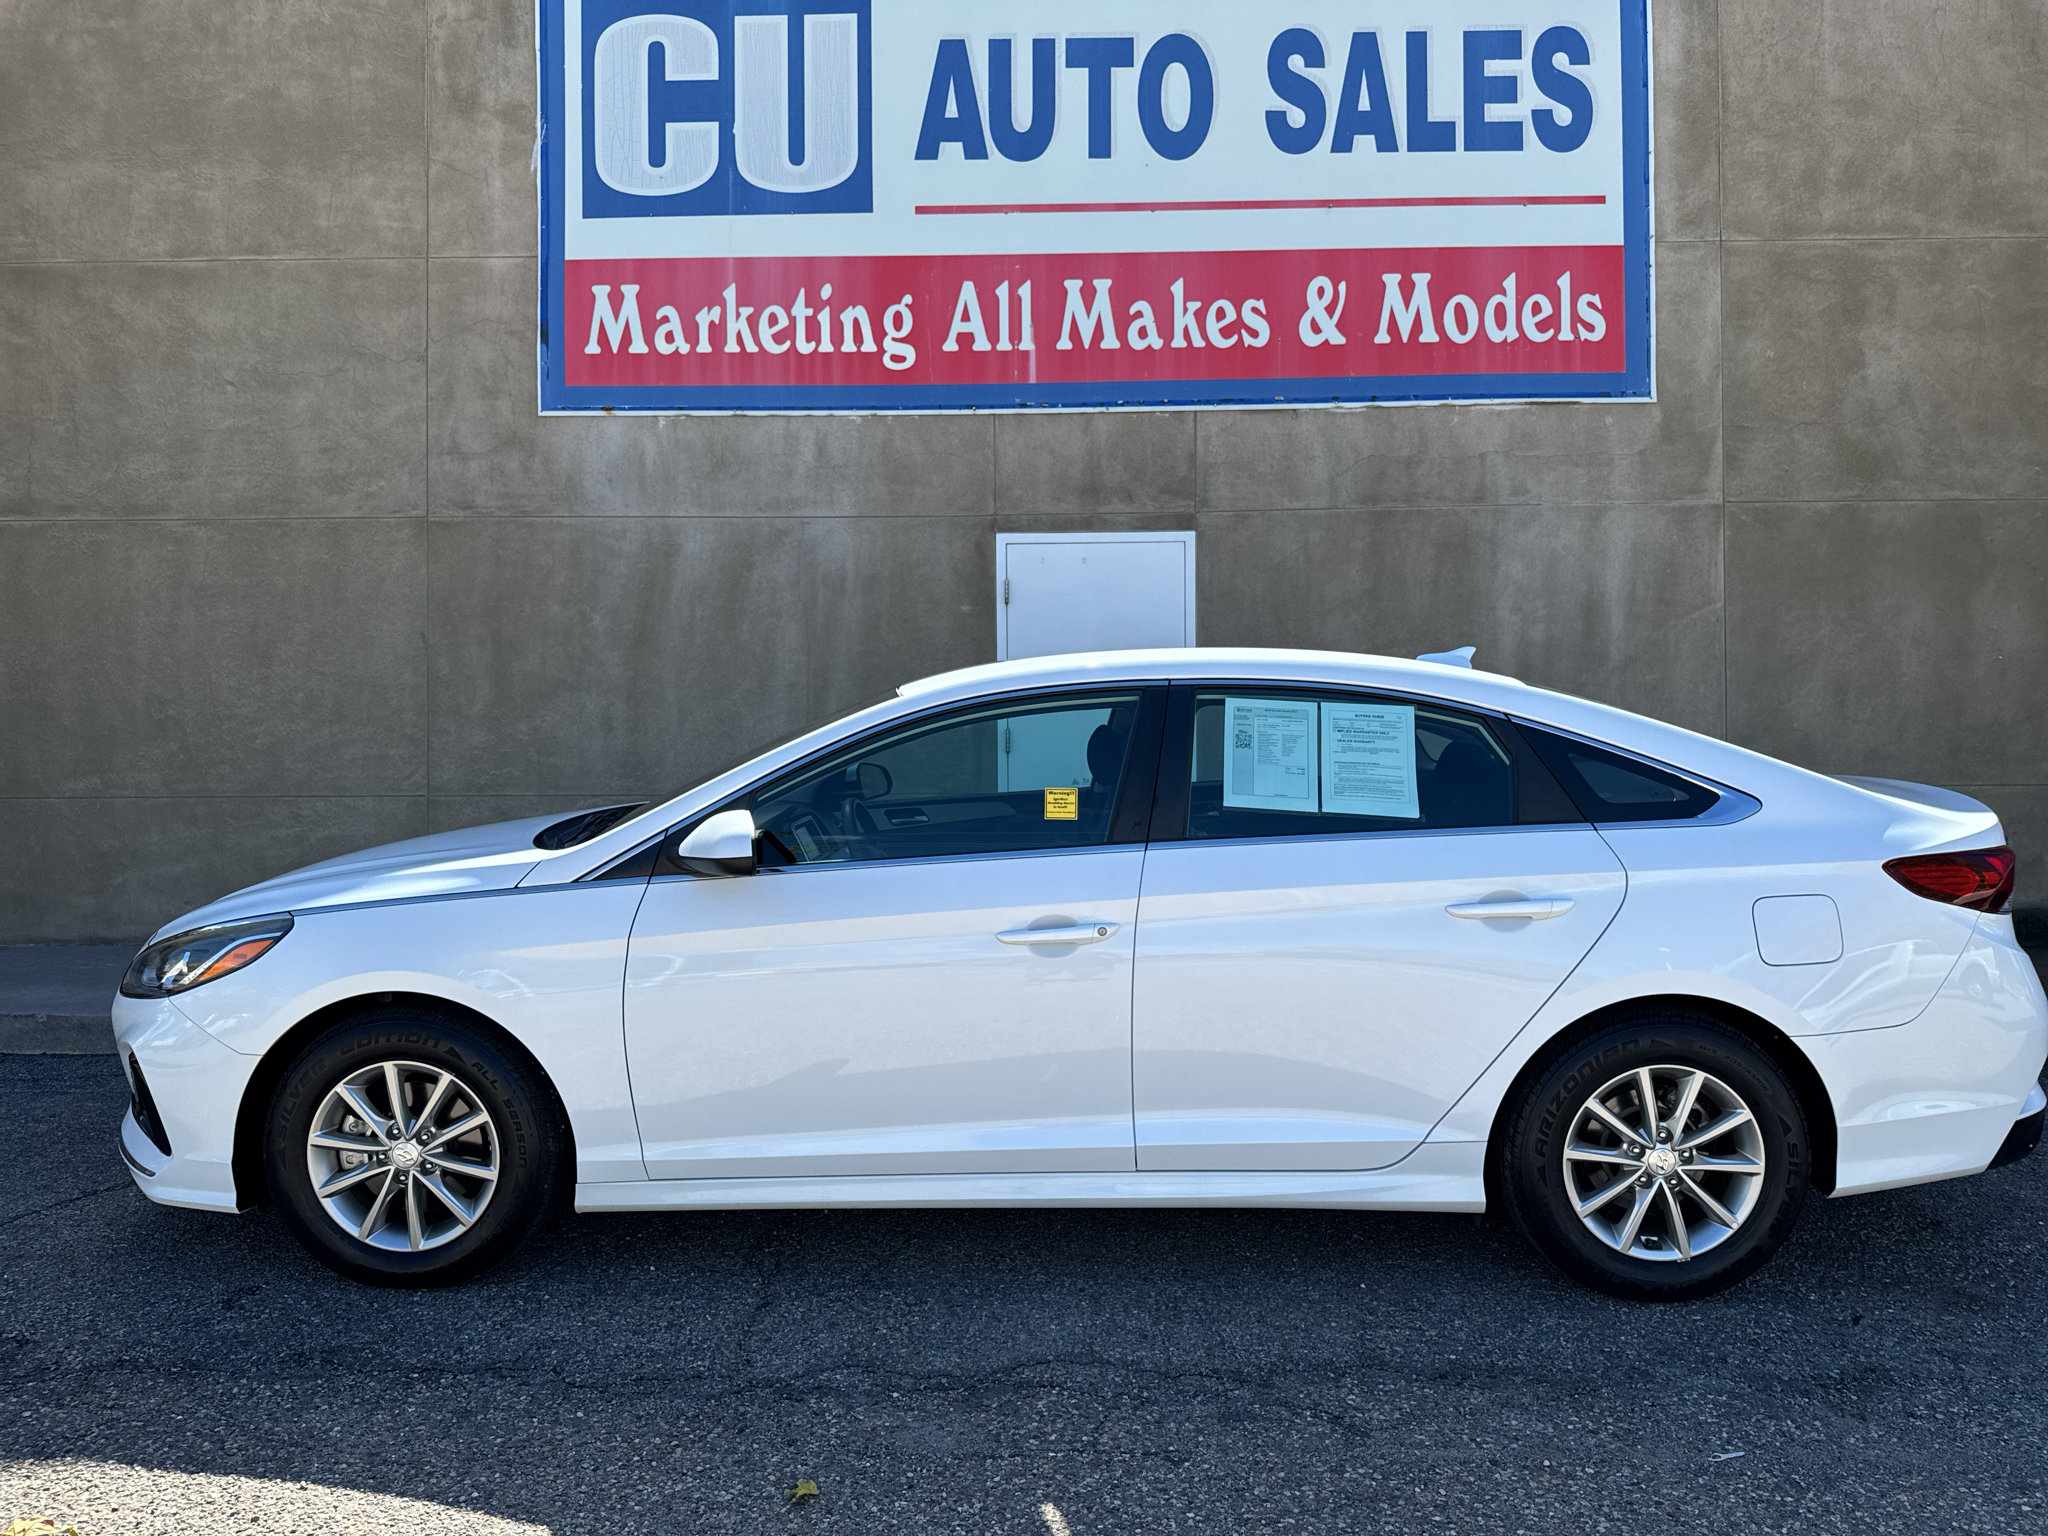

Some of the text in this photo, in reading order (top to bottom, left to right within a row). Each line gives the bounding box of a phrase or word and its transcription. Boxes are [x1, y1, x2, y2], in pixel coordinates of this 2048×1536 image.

[594, 13, 1597, 197] CU AUTO SALES
[584, 270, 1607, 370] Marketing All Makes & Models
[471, 1062, 529, 1168] ALL SEASON
[1534, 1038, 1640, 1158] ARIZONIAN
